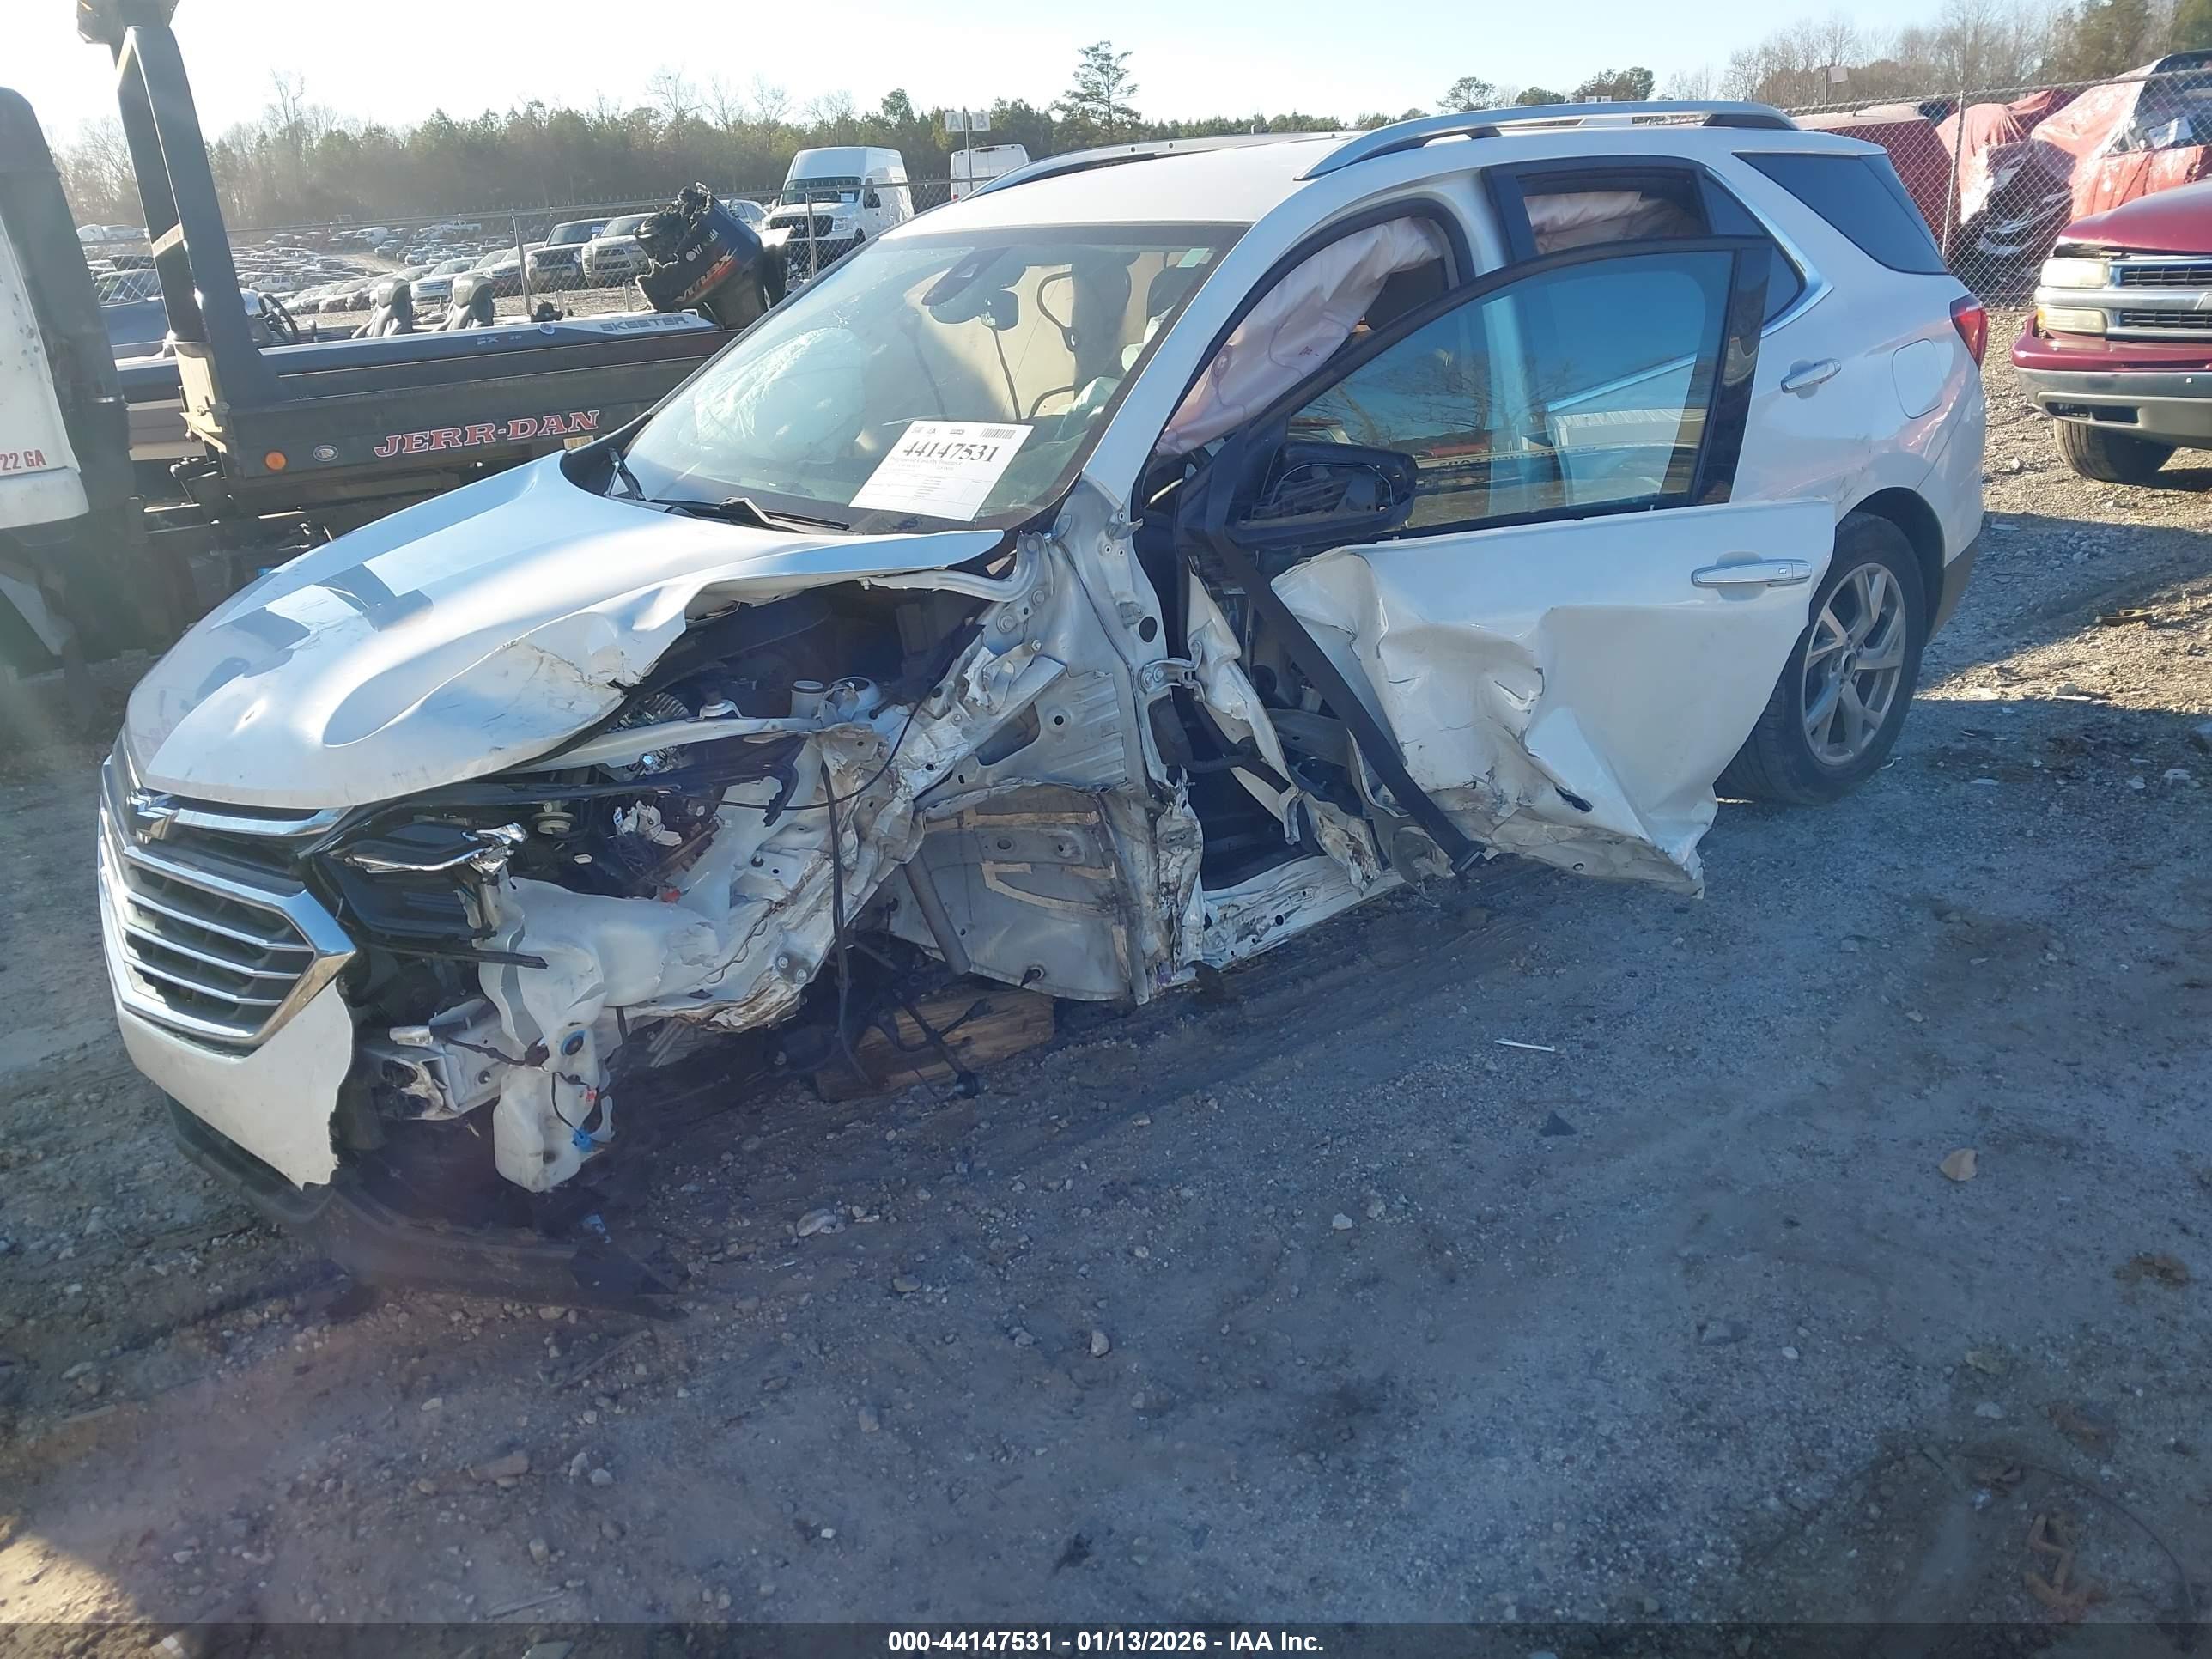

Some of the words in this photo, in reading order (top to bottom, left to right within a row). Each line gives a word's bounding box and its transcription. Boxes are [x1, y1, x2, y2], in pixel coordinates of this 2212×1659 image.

[948, 114, 962, 130] A
[975, 113, 987, 129] B
[599, 316, 689, 331] SKEETER
[374, 410, 599, 458] JERR-DAN
[23, 449, 46, 467] GA
[902, 441, 1000, 462] 44147531
